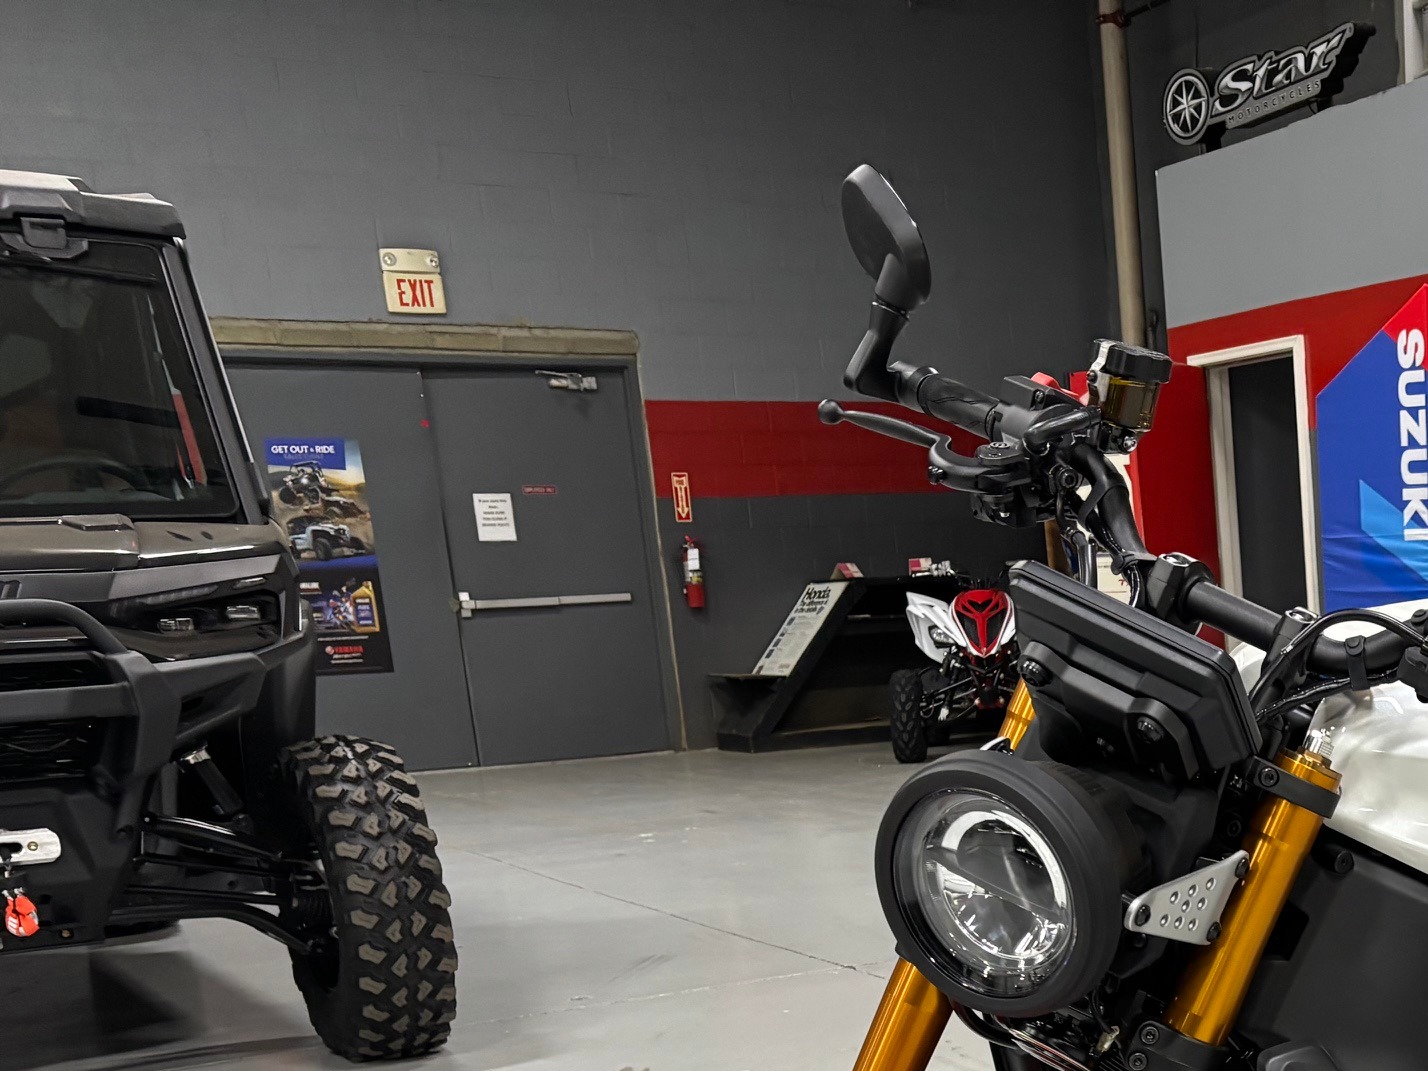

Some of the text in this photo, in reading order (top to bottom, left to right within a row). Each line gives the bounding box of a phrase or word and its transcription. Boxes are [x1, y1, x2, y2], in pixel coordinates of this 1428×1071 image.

[1212, 33, 1343, 116] Star
[1228, 80, 1320, 124] MOTORCYCLES
[396, 278, 435, 307] EXIT
[271, 445, 288, 454] GET
[290, 445, 308, 454] OUT
[315, 445, 335, 454] RIDE
